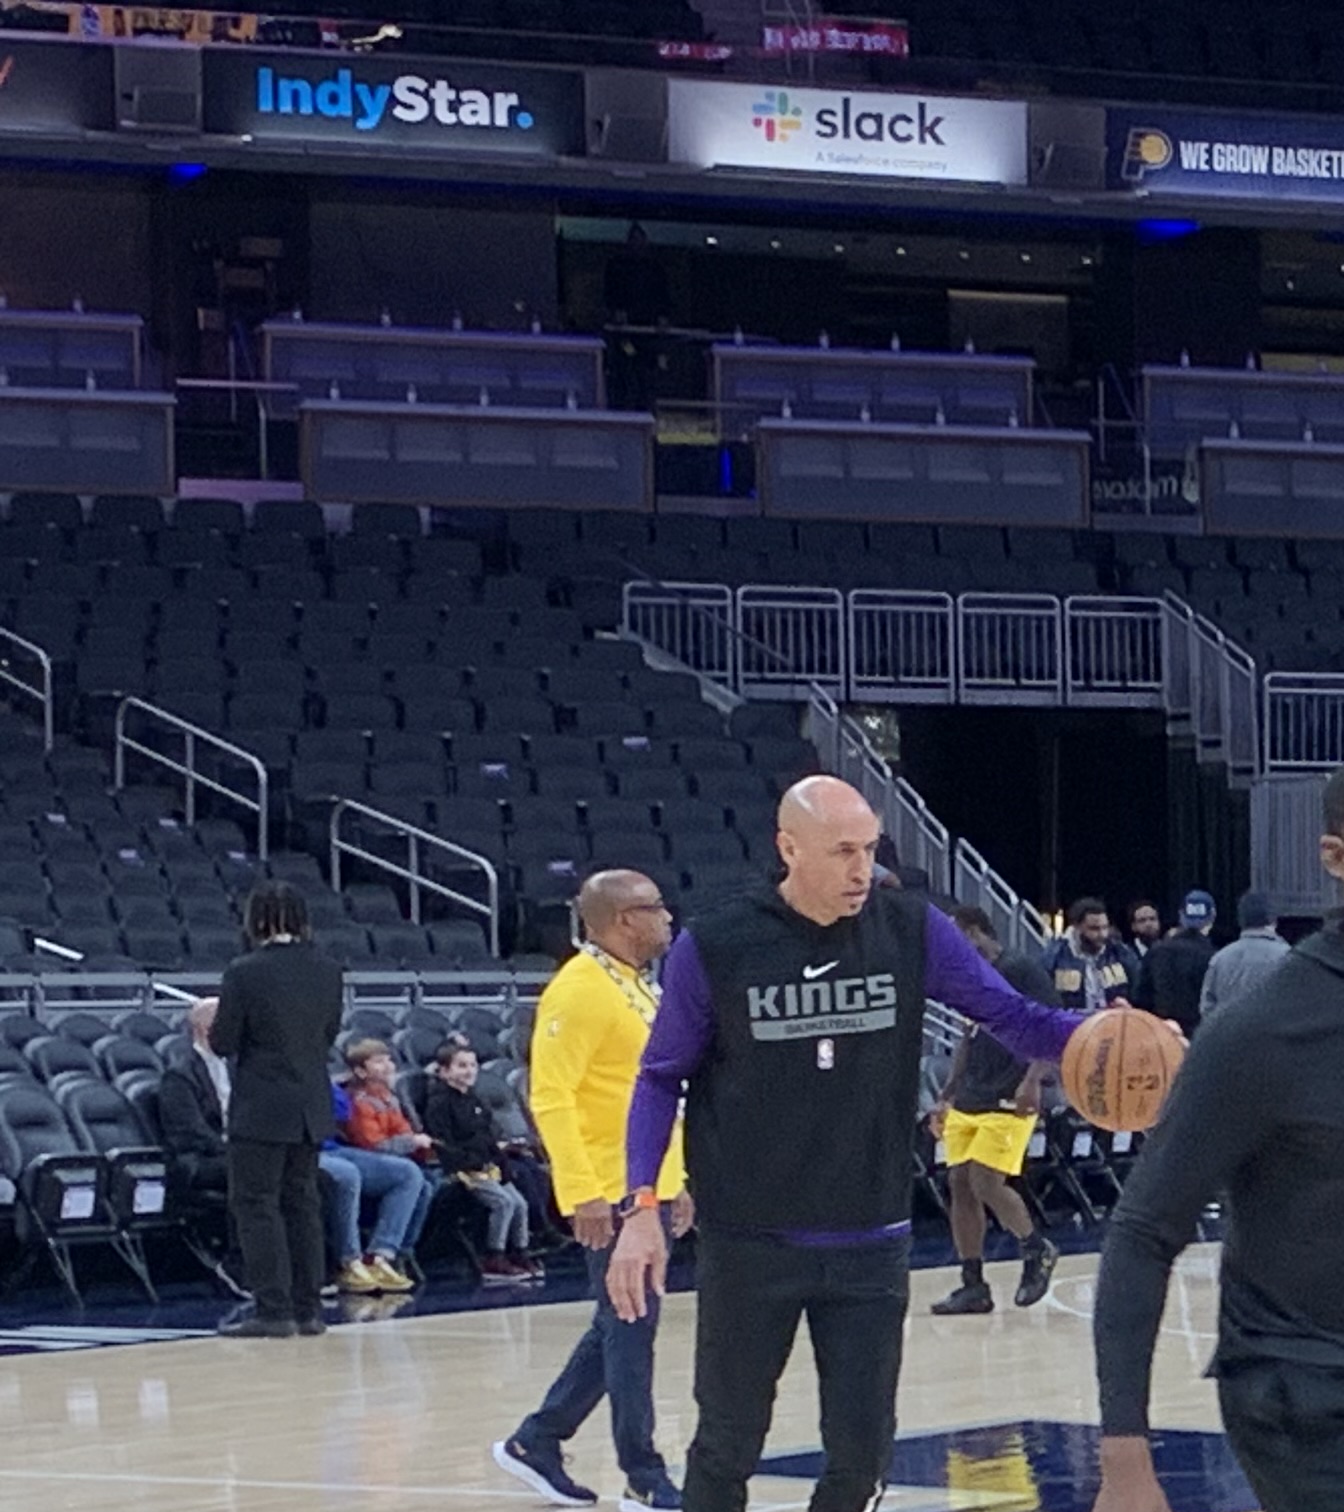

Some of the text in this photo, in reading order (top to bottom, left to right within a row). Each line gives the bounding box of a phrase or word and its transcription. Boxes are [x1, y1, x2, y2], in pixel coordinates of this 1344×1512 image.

[257, 66, 534, 131] IndyStar.
[814, 97, 947, 146] slack
[1179, 140, 1210, 171] WE
[1212, 143, 1270, 176] GROW
[747, 973, 898, 1019] KINGS
